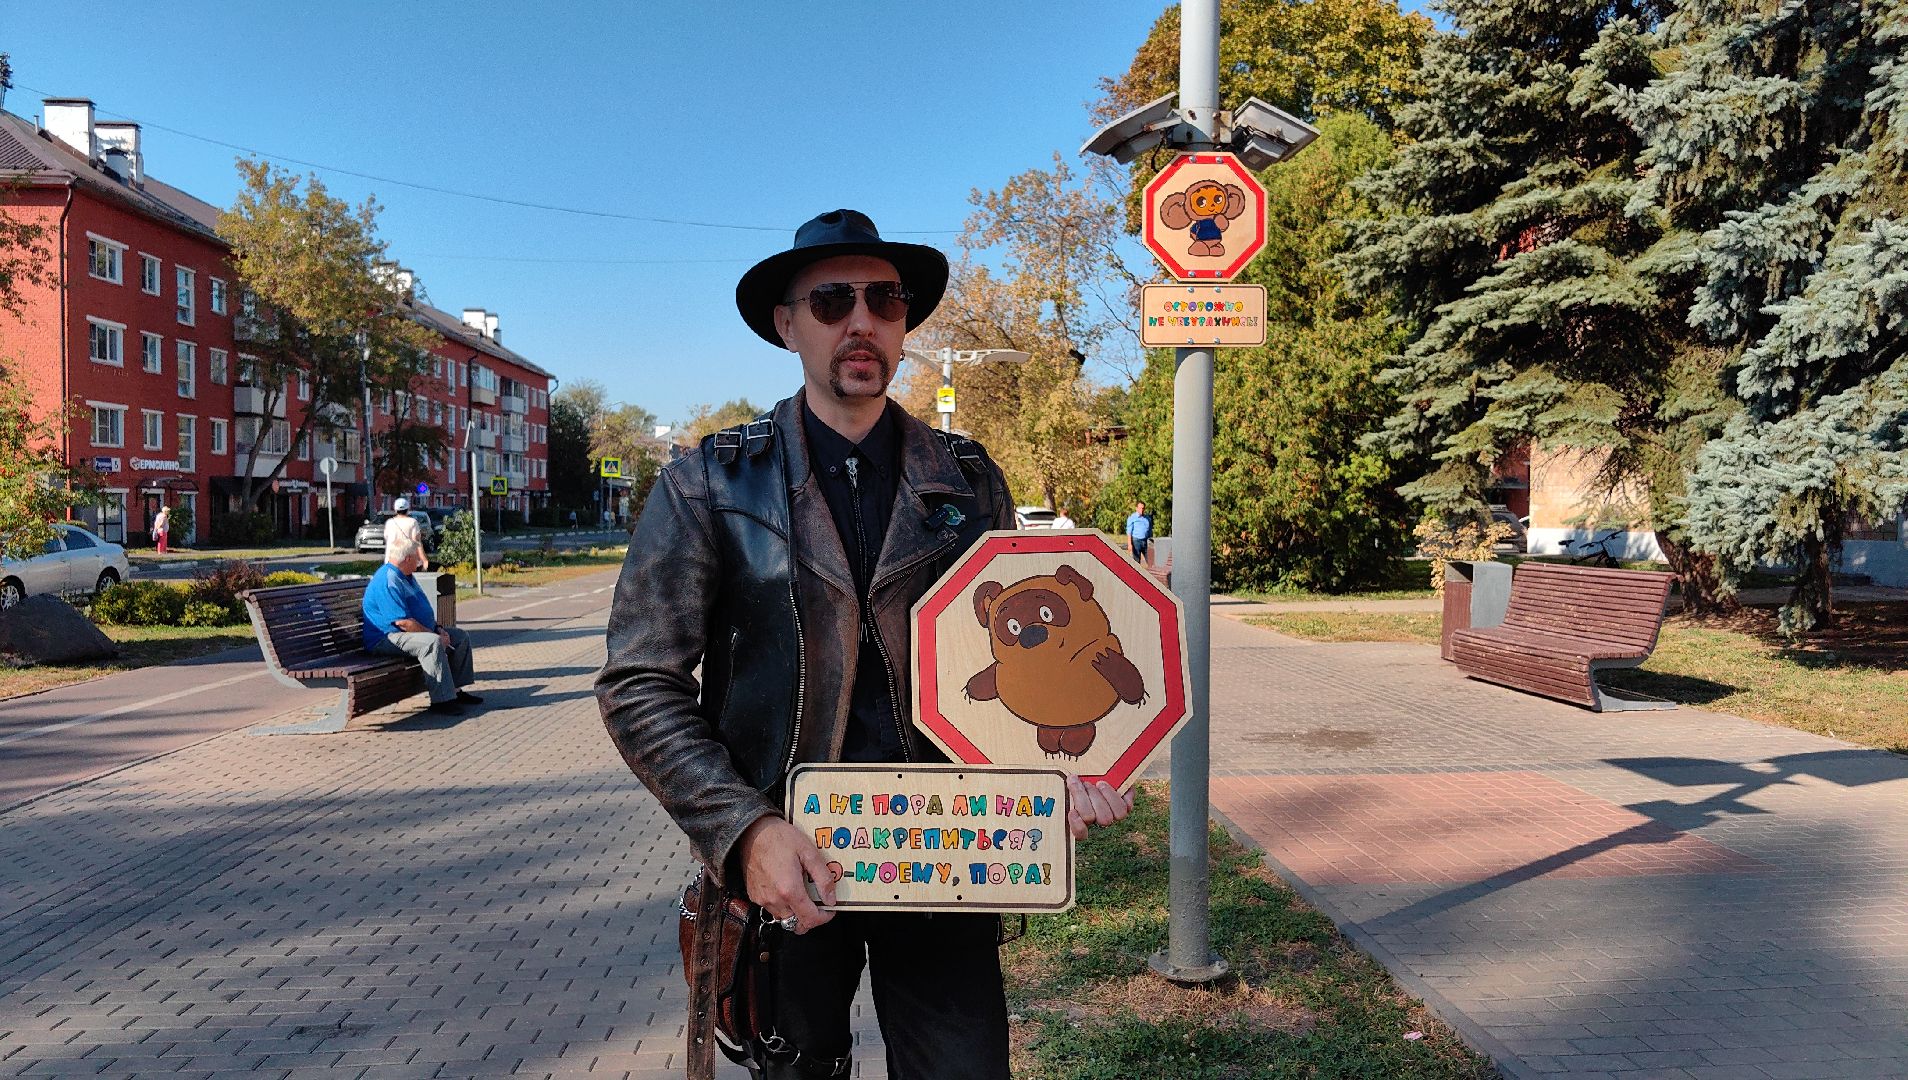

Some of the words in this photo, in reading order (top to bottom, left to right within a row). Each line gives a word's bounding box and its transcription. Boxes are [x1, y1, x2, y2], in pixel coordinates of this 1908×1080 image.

[1164, 301, 1244, 312] ОСТОРОЖНО
[1148, 316, 1165, 326] НЕ
[803, 794, 821, 814] А
[829, 793, 864, 815] НЕ
[872, 793, 944, 816] ПОРА
[952, 794, 987, 816] ЛИ
[995, 794, 1056, 817] НАМ
[814, 826, 1043, 851] ПОДКРЕПИТЬСЯ?
[808, 861, 960, 887] О-МОЕМУ,
[968, 862, 1052, 885] ПОРА!
